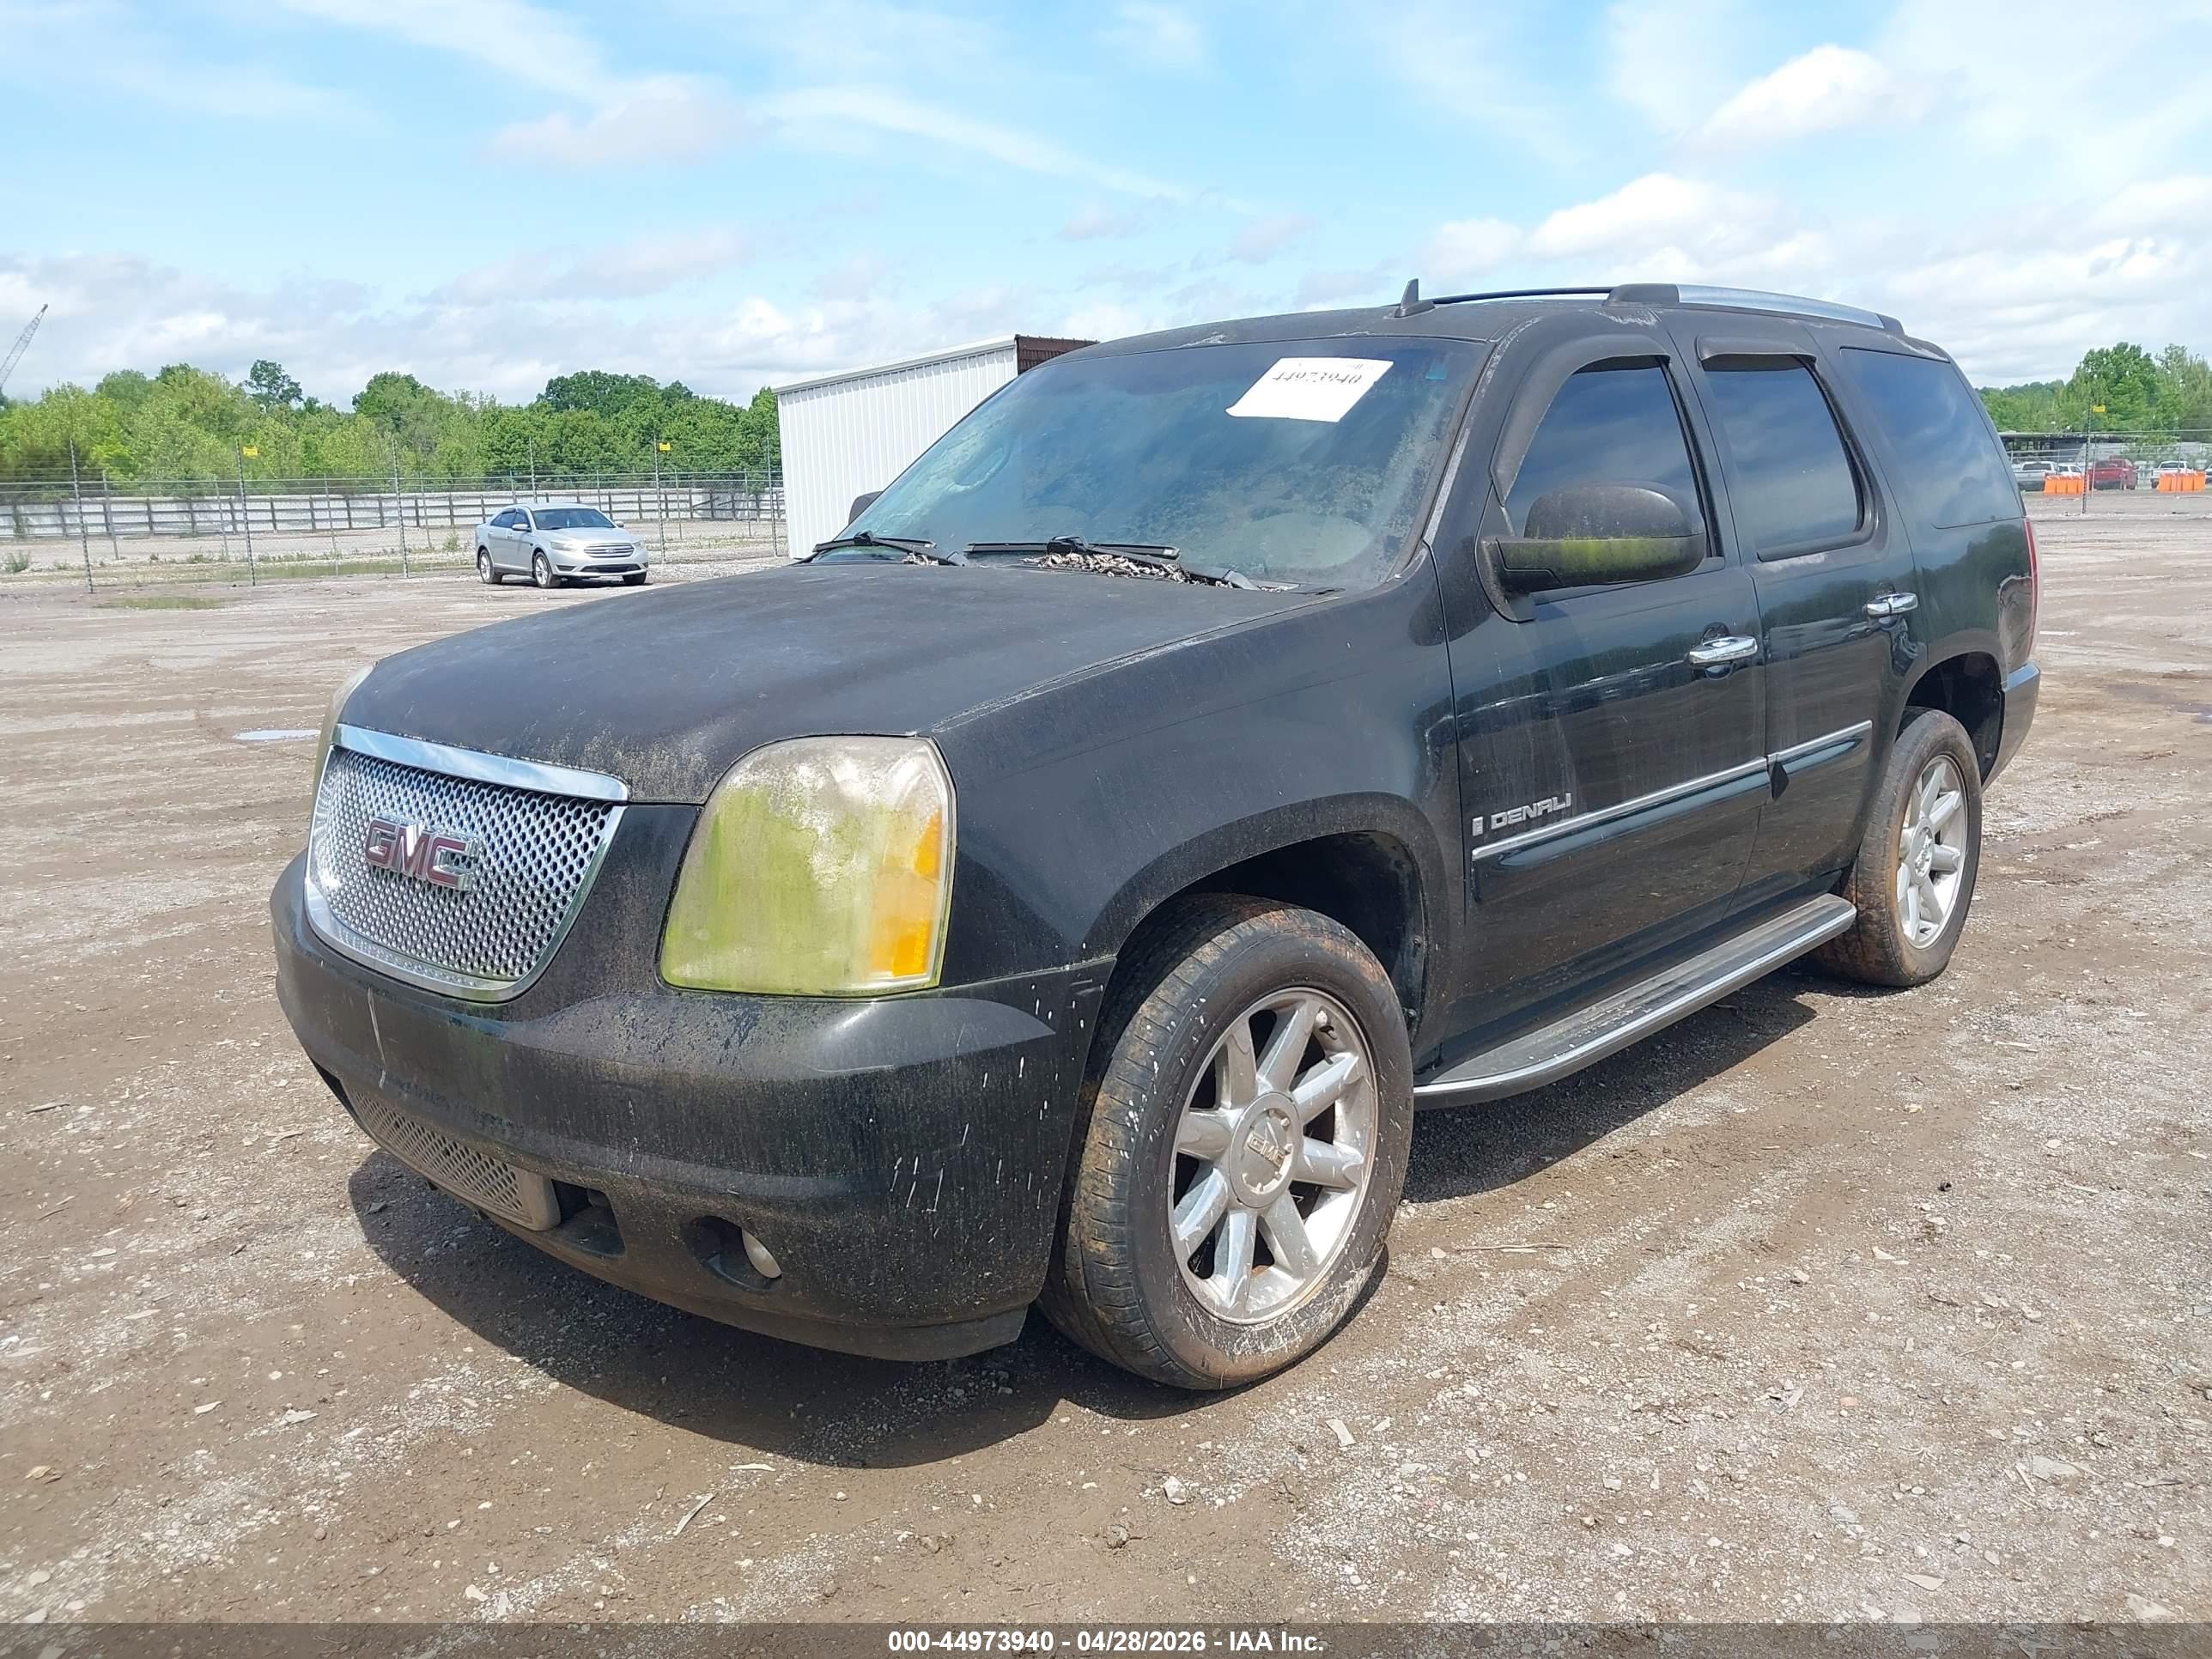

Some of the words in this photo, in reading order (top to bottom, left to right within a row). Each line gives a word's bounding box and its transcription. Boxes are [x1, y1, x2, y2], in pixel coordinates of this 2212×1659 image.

[1490, 793, 1571, 830] DENALI
[365, 816, 475, 891] GMC
[1244, 1132, 1286, 1169] GMC
